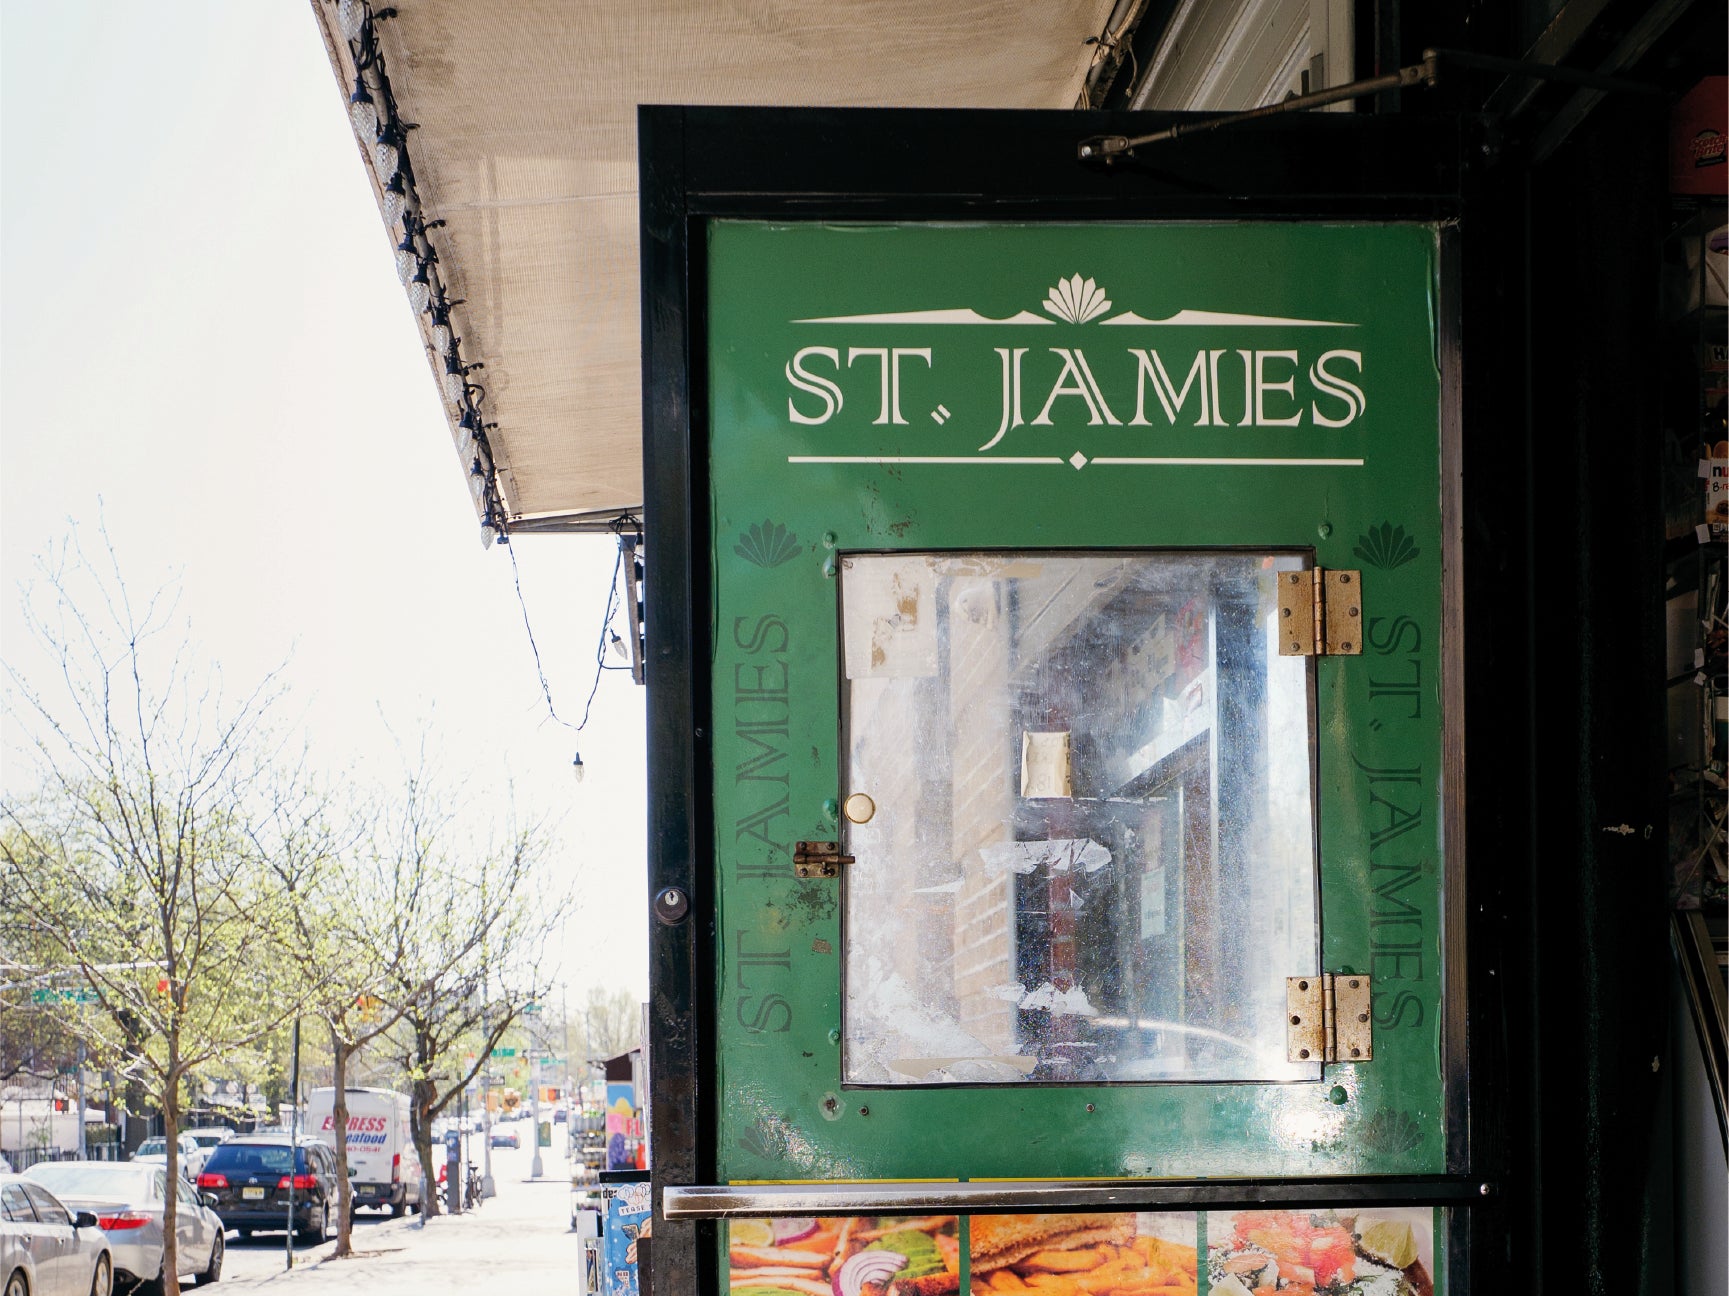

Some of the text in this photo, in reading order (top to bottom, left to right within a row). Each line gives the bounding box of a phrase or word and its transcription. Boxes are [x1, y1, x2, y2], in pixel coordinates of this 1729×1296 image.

[785, 345, 1367, 452] ST. JAMES
[733, 613, 806, 888] JAMES
[1350, 614, 1425, 1031] ST. JAMES
[321, 1115, 387, 1132] EPRESS
[346, 1132, 387, 1144] eafood
